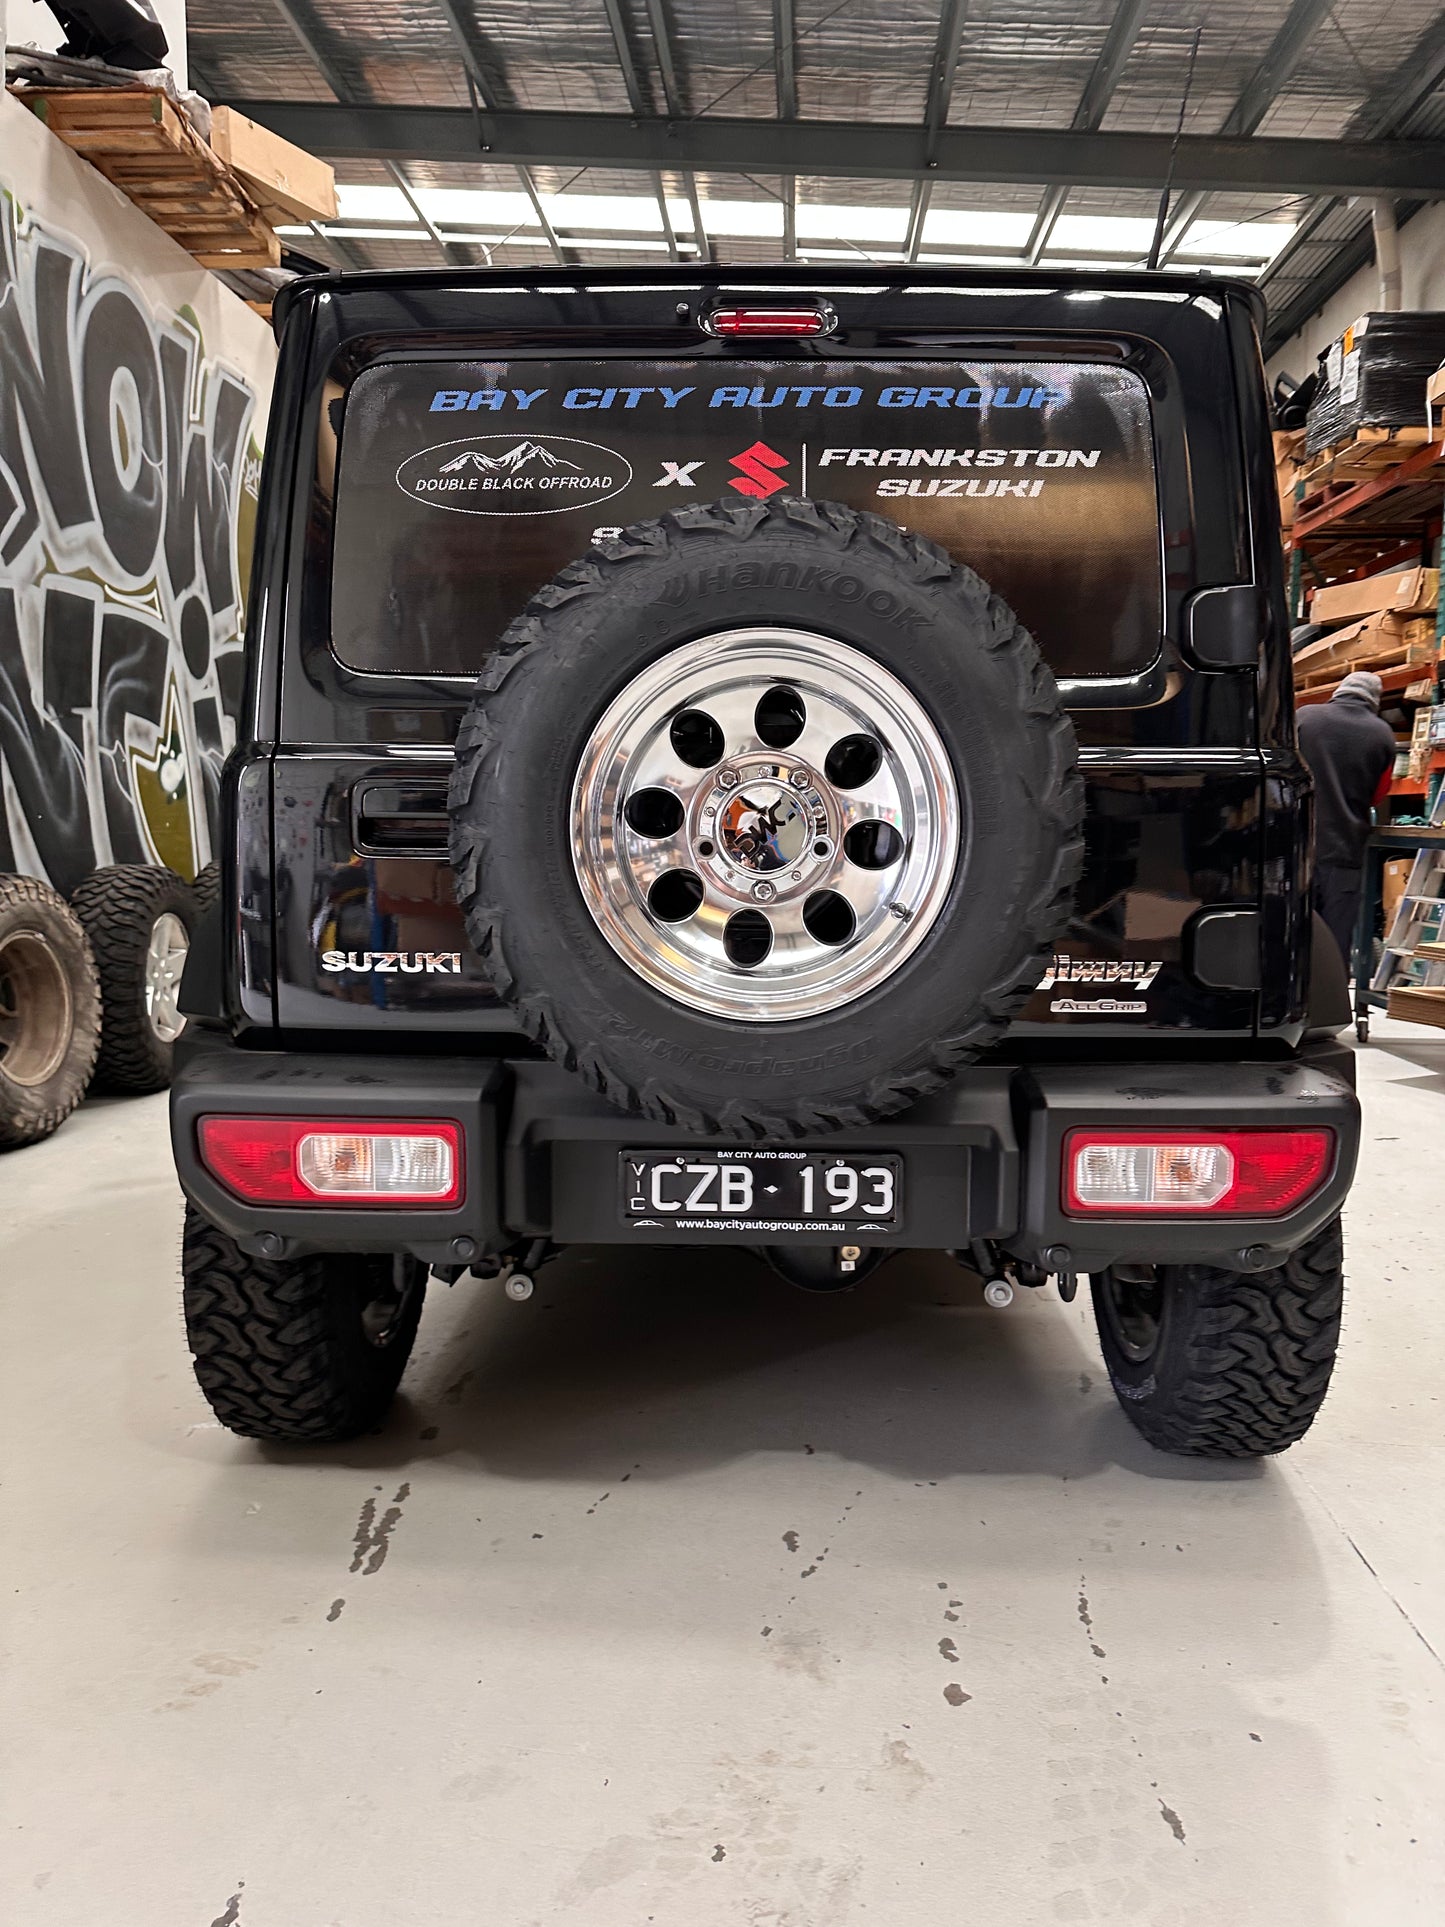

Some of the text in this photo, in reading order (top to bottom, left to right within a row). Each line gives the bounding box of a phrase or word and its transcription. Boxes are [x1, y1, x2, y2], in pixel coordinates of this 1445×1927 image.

[429, 386, 1066, 412] BAY CITY AUTO GROUP
[818, 449, 1101, 468] FRANKSTON
[415, 476, 612, 491] DOUBLE BLACK OFFROAD
[876, 479, 1045, 498] SUZUKI
[321, 951, 462, 973] SUZUKI
[734, 1151, 753, 1159] CITY
[754, 1151, 776, 1159] AUTO
[778, 1152, 807, 1160] GROUP
[651, 1163, 894, 1216] CZB 193
[676, 1219, 845, 1232] www.baycityautogroup.com.au
